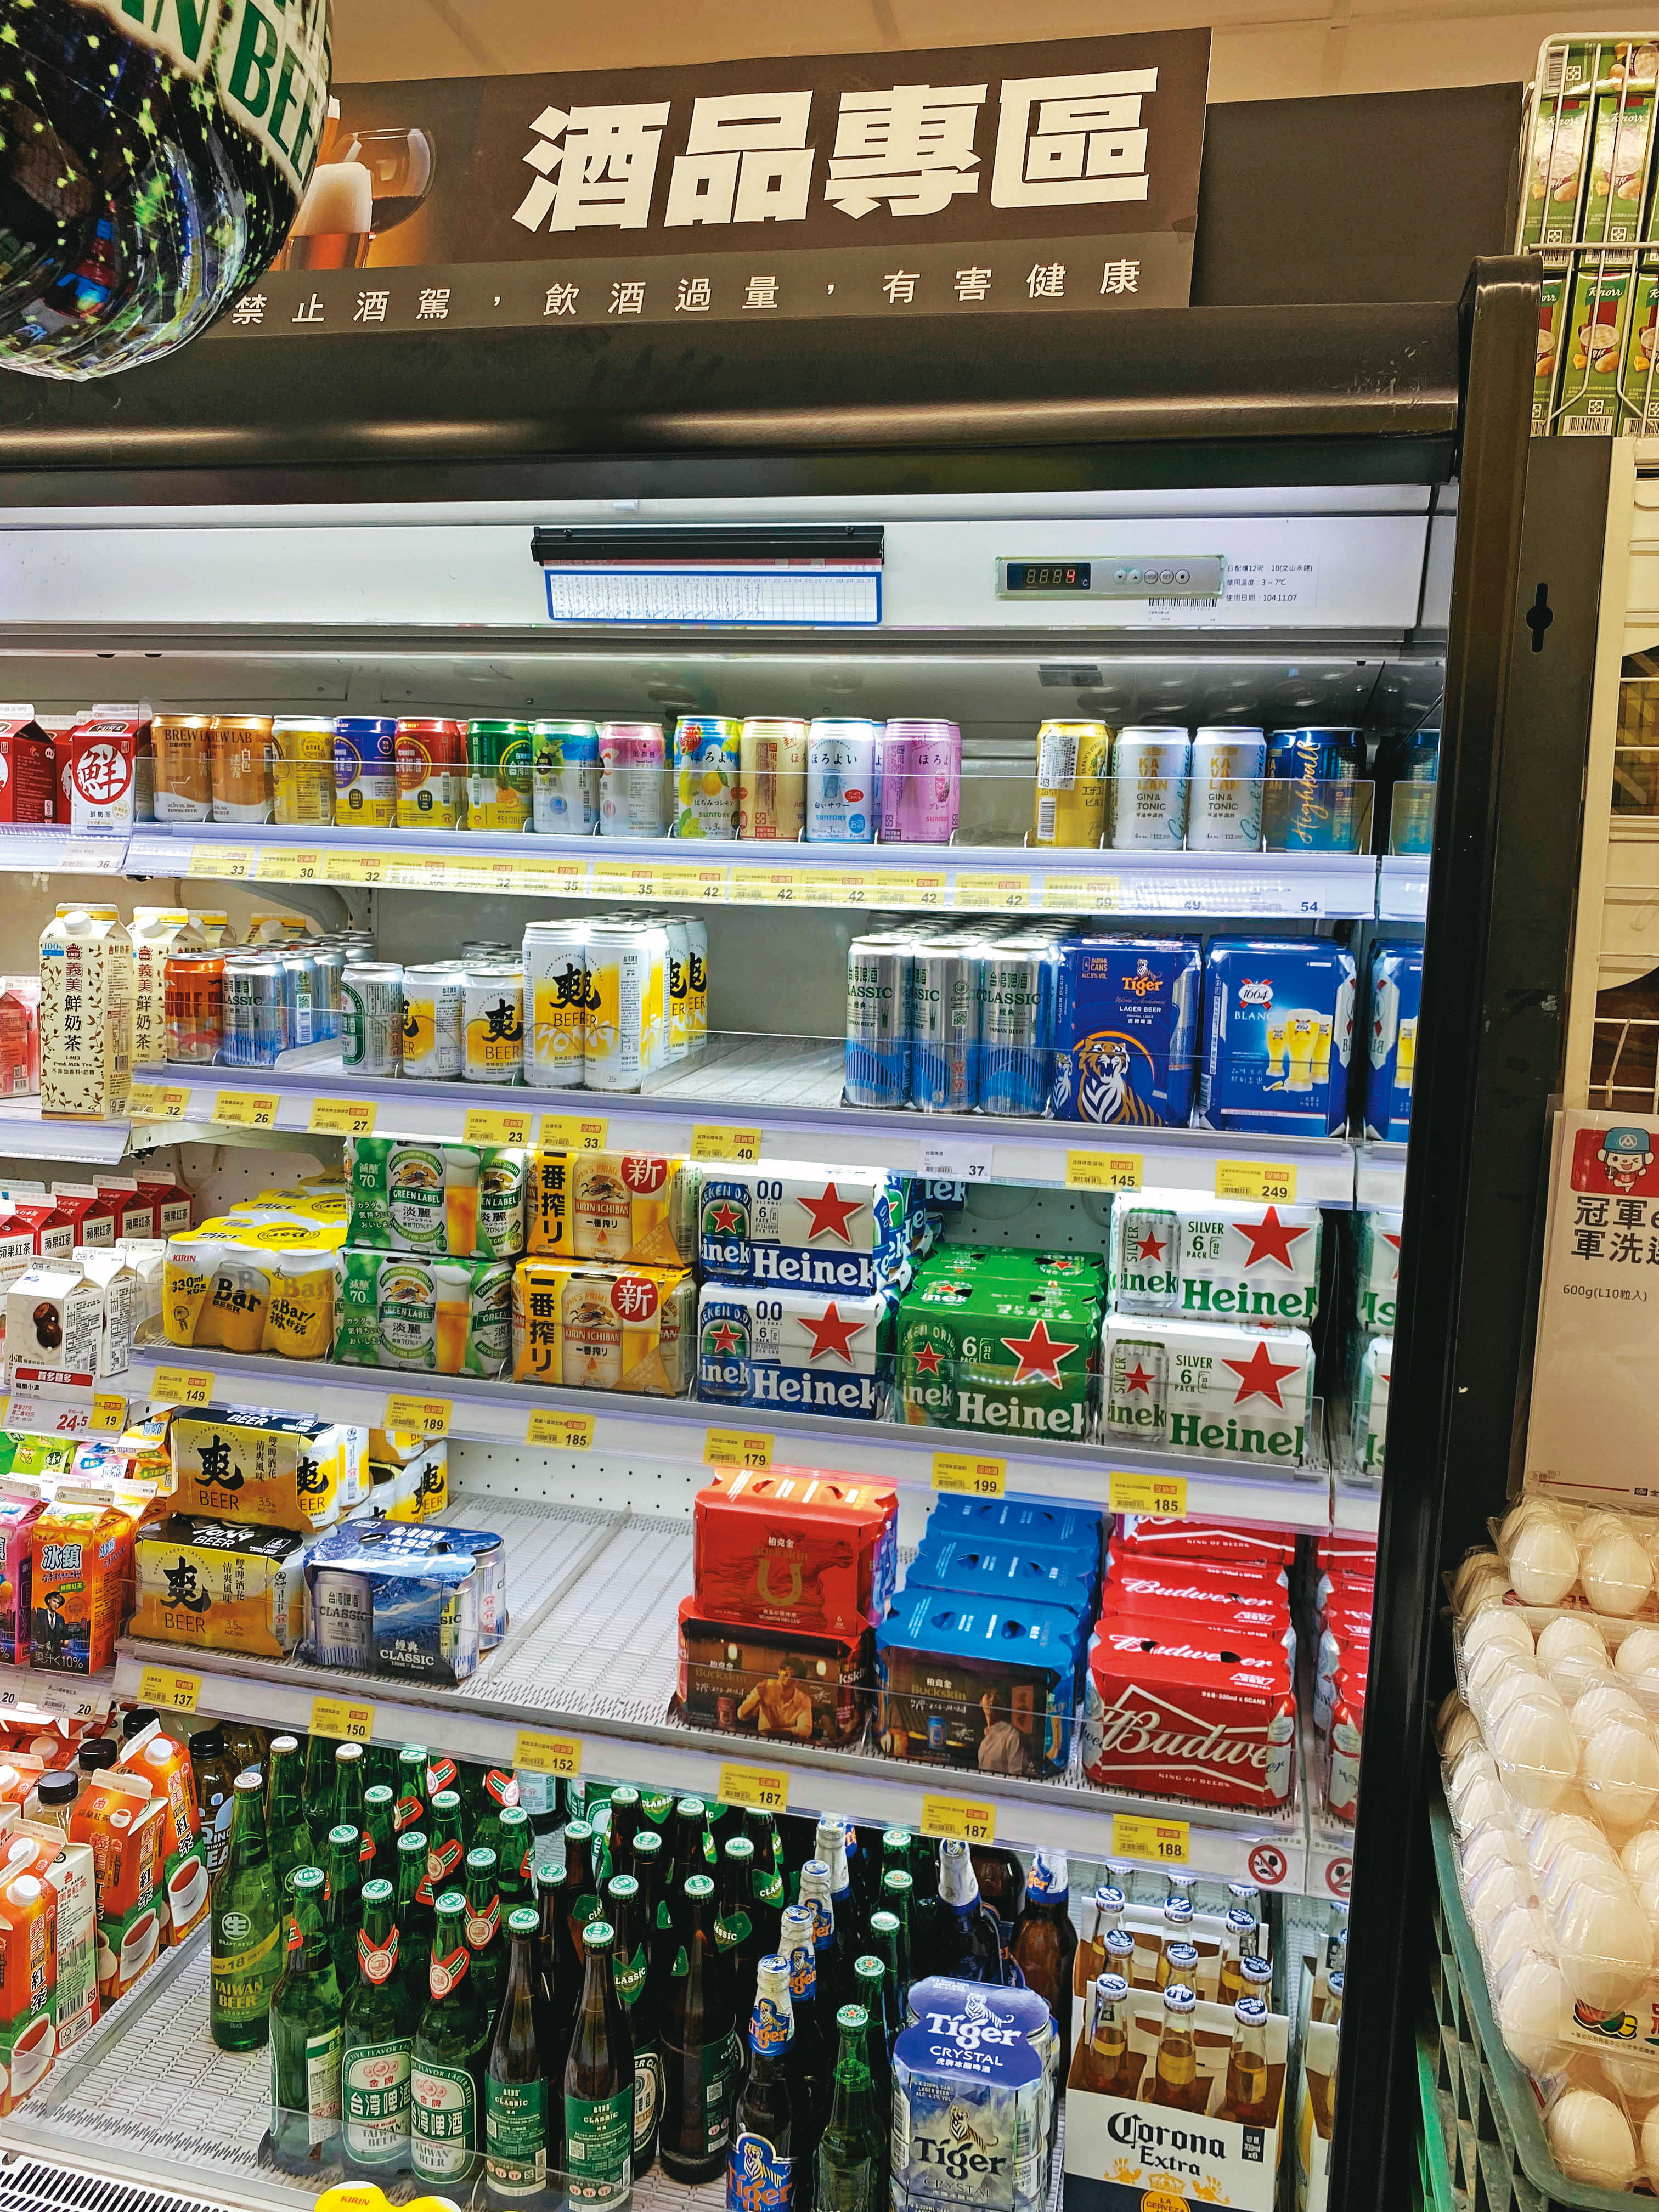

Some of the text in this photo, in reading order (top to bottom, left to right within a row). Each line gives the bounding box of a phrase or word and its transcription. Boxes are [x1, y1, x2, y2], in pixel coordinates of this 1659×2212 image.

[512, 67, 1159, 232] 酒品專區
[165, 729, 198, 741] BREW
[232, 733, 252, 743] LAB
[691, 752, 736, 763] ほろよい
[812, 754, 857, 764] ほろよい
[300, 868, 314, 878] 30
[365, 872, 380, 881] 32
[637, 884, 653, 894] 35
[703, 887, 719, 896] 42
[777, 889, 793, 899] 42
[1301, 902, 1318, 912] 54
[1091, 963, 1108, 972] CANS
[1121, 976, 1163, 997] Tiger
[982, 990, 1041, 1005] CLASSIC
[1243, 989, 1268, 1000] 1664
[482, 998, 522, 1043] 爽
[485, 1045, 519, 1059] BEER
[166, 1106, 180, 1115] 32
[255, 1113, 268, 1123] 26
[353, 1120, 368, 1130] 27
[508, 1132, 523, 1142] 23
[584, 1137, 599, 1149] 33
[737, 1149, 753, 1159] 40
[627, 1158, 663, 1188] 新
[968, 1165, 984, 1176] 37
[1110, 1175, 1135, 1187] 145
[393, 1189, 440, 1203] GREEN LABEL
[757, 1180, 783, 1200] 0.0
[1262, 1186, 1288, 1198] 249
[493, 1197, 517, 1206] LABEL
[541, 1152, 567, 1244] 一番搾り
[402, 1206, 431, 1218] 淡麗
[576, 1202, 629, 1215] KIRIN ICHIBAN
[759, 1207, 767, 1217] 6
[164, 1208, 188, 1223] 蘋果紅茶
[126, 1215, 151, 1232] 蘋果紅茶
[586, 1218, 617, 1228] 一番搾り
[1187, 1221, 1224, 1235] SILVER
[86, 1223, 111, 1240] 蘋果紅茶
[44, 1233, 71, 1251] 蘋果紅茶
[1127, 1226, 1139, 1262] SILVER
[1192, 1236, 1204, 1251] 6
[214, 1278, 261, 1312] Bar
[618, 1281, 653, 1314] 新
[1563, 1284, 1647, 1302] 600g(L10粒入)
[384, 1306, 431, 1319] GREEN LABEL
[756, 1300, 782, 1321] 0.0
[392, 1322, 421, 1333] 淡麗
[529, 1276, 555, 1372] 一番搾り
[566, 1326, 620, 1342] KIRIN ICHIBAN
[759, 1327, 767, 1338] 6
[575, 1347, 608, 1357] 一番搾り
[962, 1336, 977, 1357] 6
[1176, 1355, 1212, 1369] SILVER
[1114, 1357, 1126, 1394] SILVER
[1180, 1369, 1192, 1384] 6
[1175, 1384, 1195, 1392] PACK
[186, 1390, 205, 1402] 149
[56, 1414, 88, 1431] 24.5
[105, 1415, 117, 1425] 19
[423, 1418, 444, 1430] 189
[566, 1434, 586, 1446] 185
[195, 1434, 245, 1491] 爽
[255, 1440, 265, 1482] 清爽風味
[744, 1454, 766, 1466] 179
[974, 1479, 997, 1492] 199
[199, 1489, 240, 1510] BEER
[1154, 1499, 1178, 1512] 185
[193, 1535, 235, 1548] BEER
[768, 1537, 794, 1548] 柏克金
[42, 1544, 82, 1569] 冰鎮
[160, 1555, 212, 1613] 爽
[319, 1606, 368, 1622] CLASSIC
[165, 1612, 207, 1634] BEER
[380, 1650, 435, 1666] CLASSIC
[926, 1677, 952, 1689] 柏克金
[2, 1692, 15, 1704] 20
[911, 1685, 967, 1701] Buckskin
[173, 1694, 193, 1706] 137
[77, 1704, 91, 1716] 20
[346, 1724, 365, 1736] 150
[552, 1758, 573, 1771] 152
[1158, 1773, 1182, 1781] KING
[759, 1792, 781, 1804] 187
[176, 1813, 194, 1857] 紅茶
[964, 1825, 987, 1837] 187
[1158, 1842, 1182, 1857] 188
[138, 1865, 154, 1911] 紅茶
[228, 1957, 245, 1970] 18
[30, 1964, 48, 2016] 紅茶
[215, 1976, 263, 1996] TAIWAN
[219, 1995, 256, 2008] BEER
[926, 2012, 1022, 2051] Tiger
[367, 2046, 397, 2057] FLAVOR
[930, 2045, 1003, 2066] CRYSTAL
[419, 2065, 444, 2077] FLAVOR
[369, 2076, 393, 2088] 金牌
[421, 2095, 441, 2108] 金牌
[495, 2096, 528, 2107] CLASSIC
[583, 2111, 619, 2124] CLASSIC
[363, 2123, 402, 2138] TAIWAN
[1107, 2111, 1227, 2159] Corona
[368, 2136, 397, 2147] BEER
[416, 2141, 449, 2158] TAIWAN
[419, 2154, 444, 2167] BEER
[914, 2136, 1006, 2181] Tiger
[1139, 2145, 1200, 2176] Extra
[924, 2176, 991, 2197] CRYSTAL
[340, 2194, 370, 2206] KIRIN
